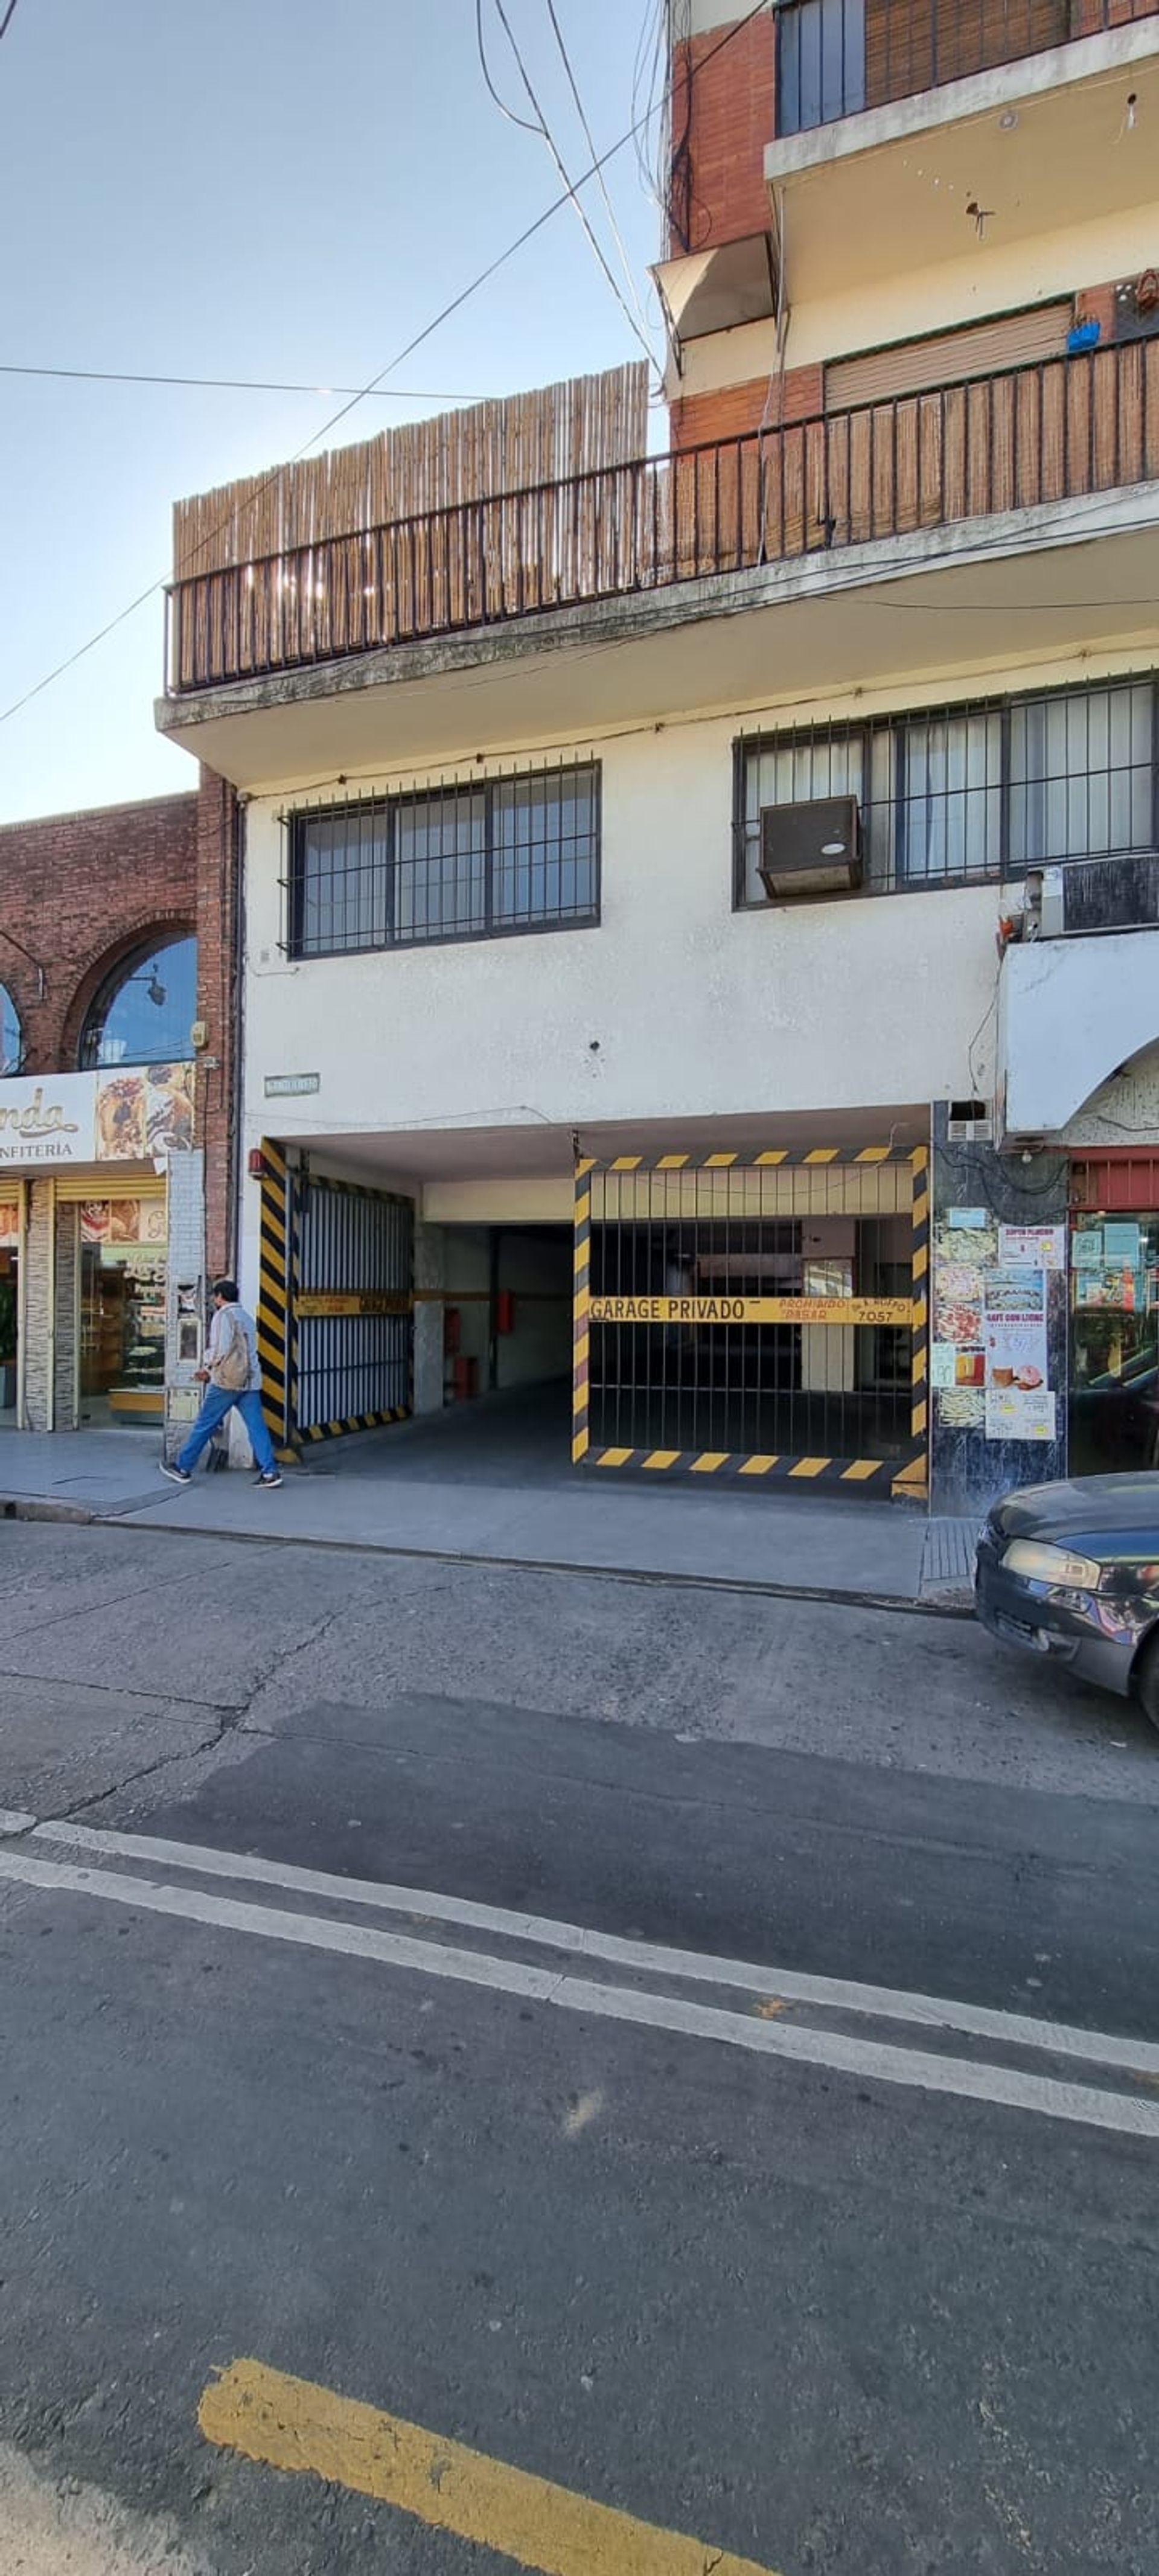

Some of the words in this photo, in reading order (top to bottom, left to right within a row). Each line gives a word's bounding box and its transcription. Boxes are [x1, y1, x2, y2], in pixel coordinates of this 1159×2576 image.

[590, 1299, 660, 1319] GARAGE
[668, 1300, 744, 1319] PRIVADO
[858, 1312, 893, 1322] 7057
